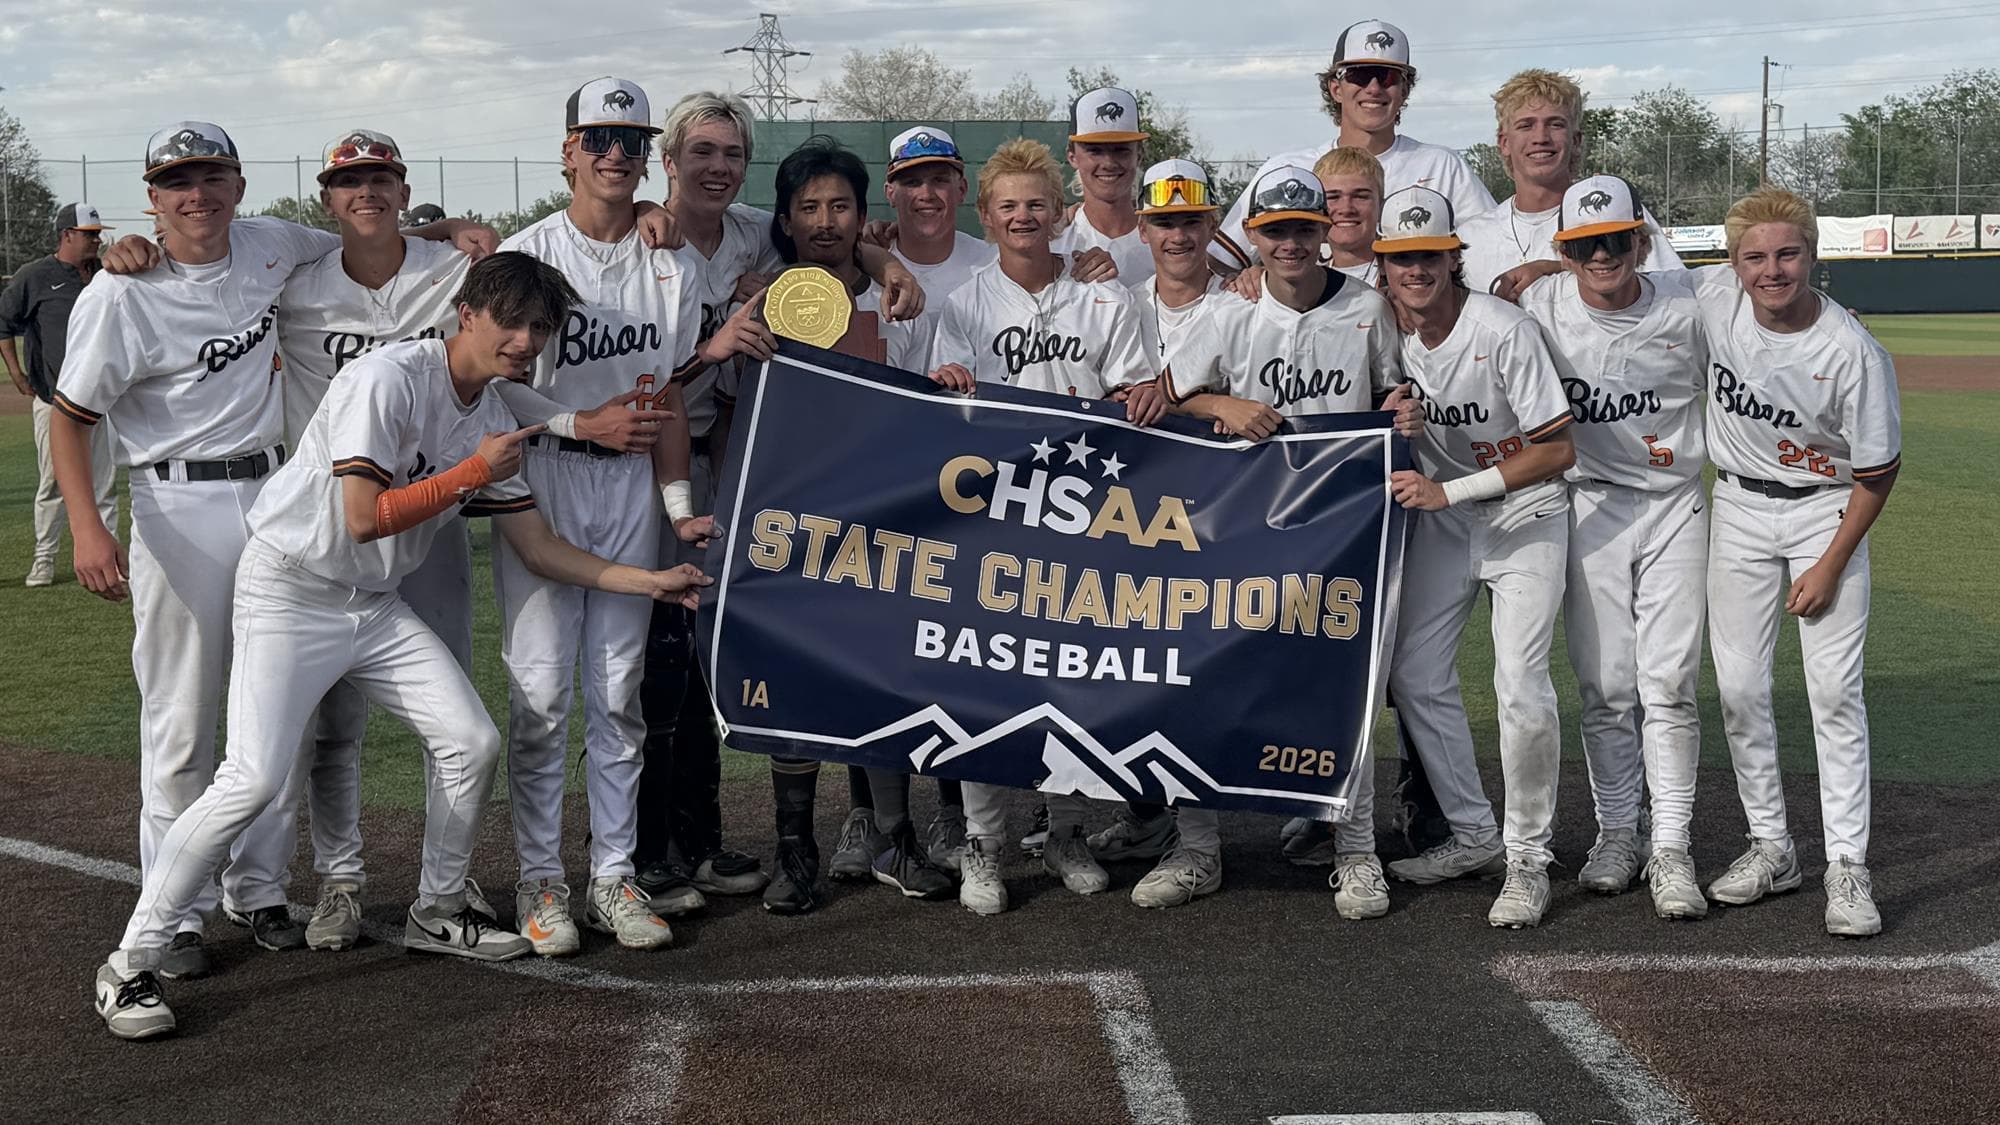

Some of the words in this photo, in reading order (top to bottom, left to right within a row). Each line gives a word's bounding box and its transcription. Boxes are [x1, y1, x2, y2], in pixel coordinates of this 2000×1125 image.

[556, 310, 661, 369] Bison
[992, 326, 1087, 382] Bison
[1259, 357, 1351, 409] Bison
[1559, 377, 1661, 424] Bison
[1713, 363, 1802, 428] Bison
[1642, 433, 1673, 467] 5
[1777, 440, 1836, 477] 22
[938, 455, 1200, 552] CHSAA
[748, 509, 956, 602] STATE
[978, 551, 1363, 639] CHAMPIONS
[914, 620, 1191, 685] BASEBALL
[742, 678, 770, 709] 1A
[1258, 744, 1336, 777] 2026
